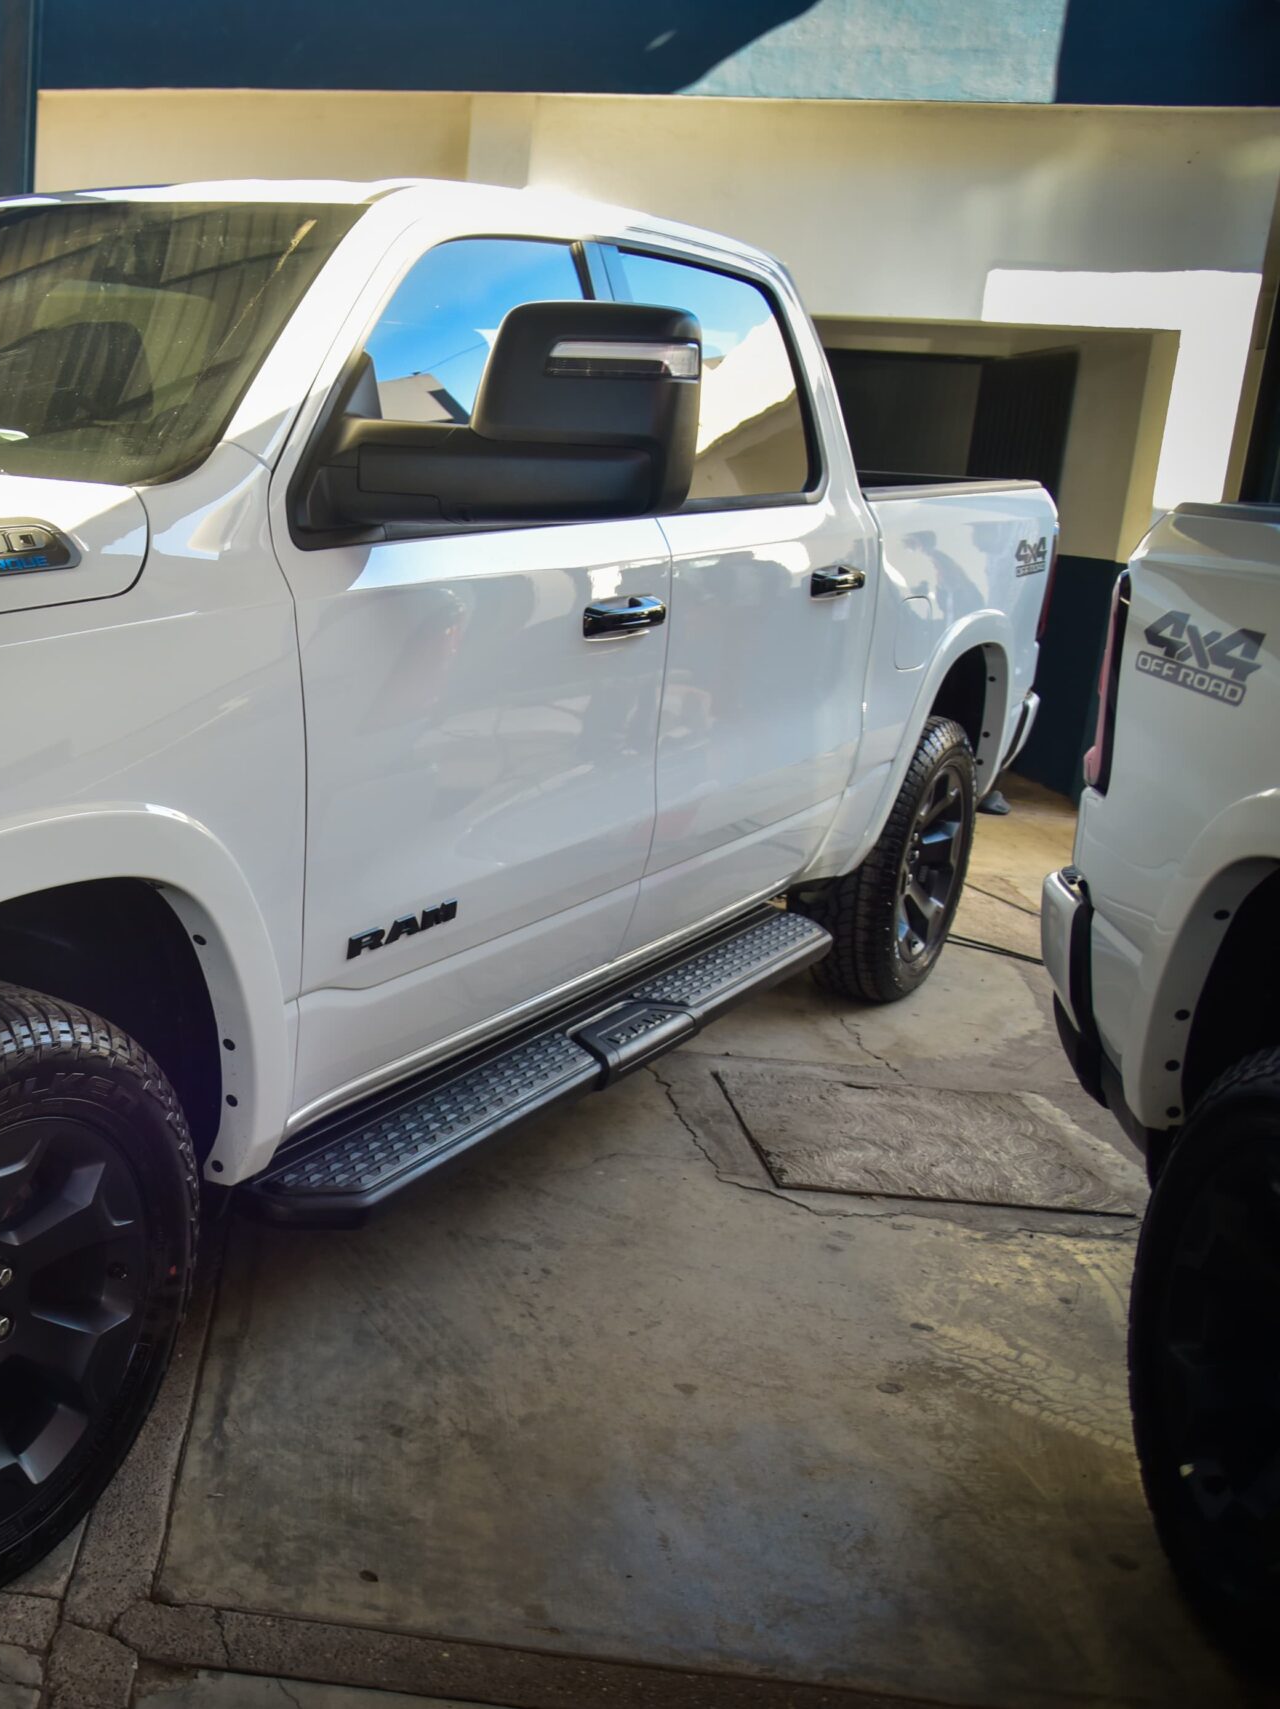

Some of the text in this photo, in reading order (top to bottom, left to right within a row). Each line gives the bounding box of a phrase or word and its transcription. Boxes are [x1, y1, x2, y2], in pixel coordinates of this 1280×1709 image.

[1138, 653, 1244, 703] OFF ROAD
[346, 898, 458, 960] RAM
